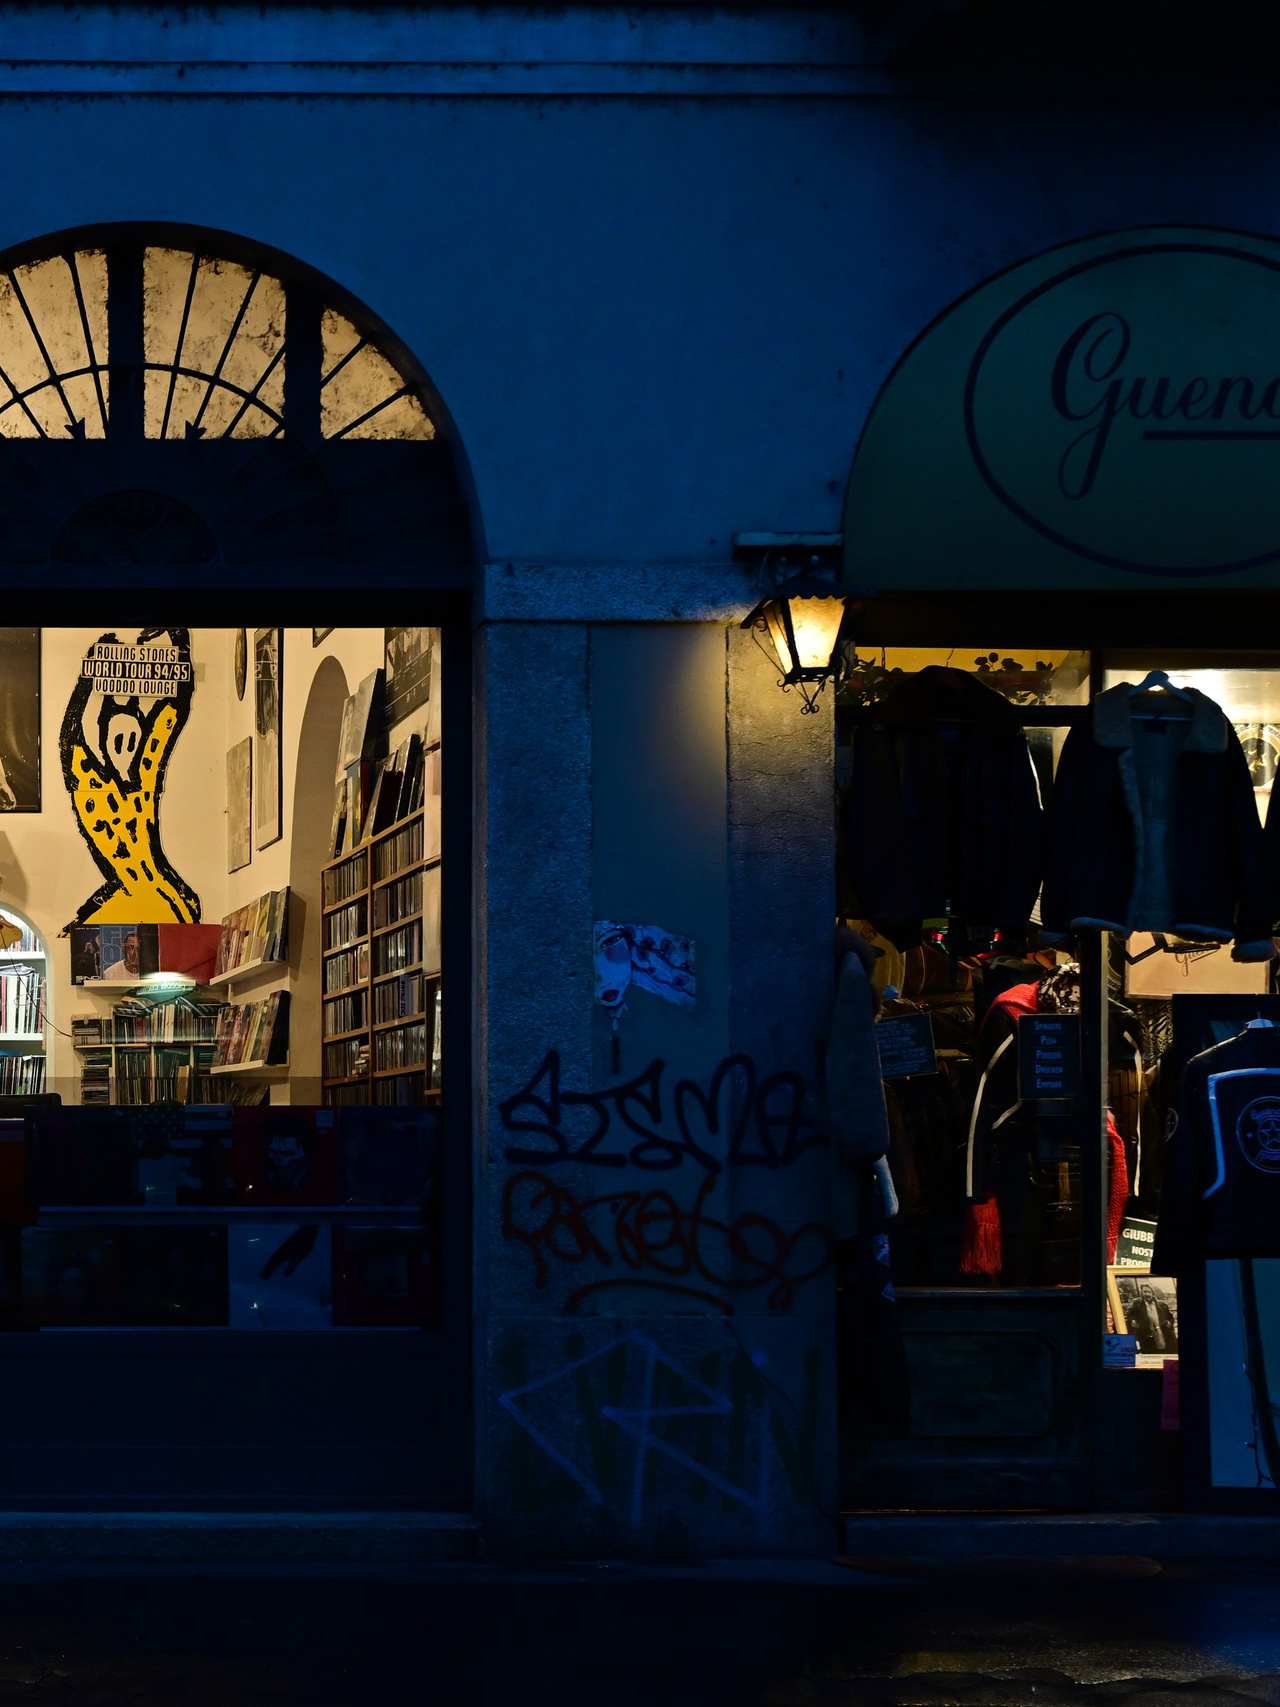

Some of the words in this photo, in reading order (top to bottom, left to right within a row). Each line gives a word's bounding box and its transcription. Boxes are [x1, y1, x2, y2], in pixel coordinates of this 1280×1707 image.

[97, 645, 136, 660] ROLLING
[139, 648, 176, 662] STONES
[84, 661, 123, 677] WORLD
[124, 663, 152, 678] TOUR
[154, 665, 188, 680] 94/95
[95, 679, 135, 693] VOODOO
[138, 680, 175, 695] LOUNGE
